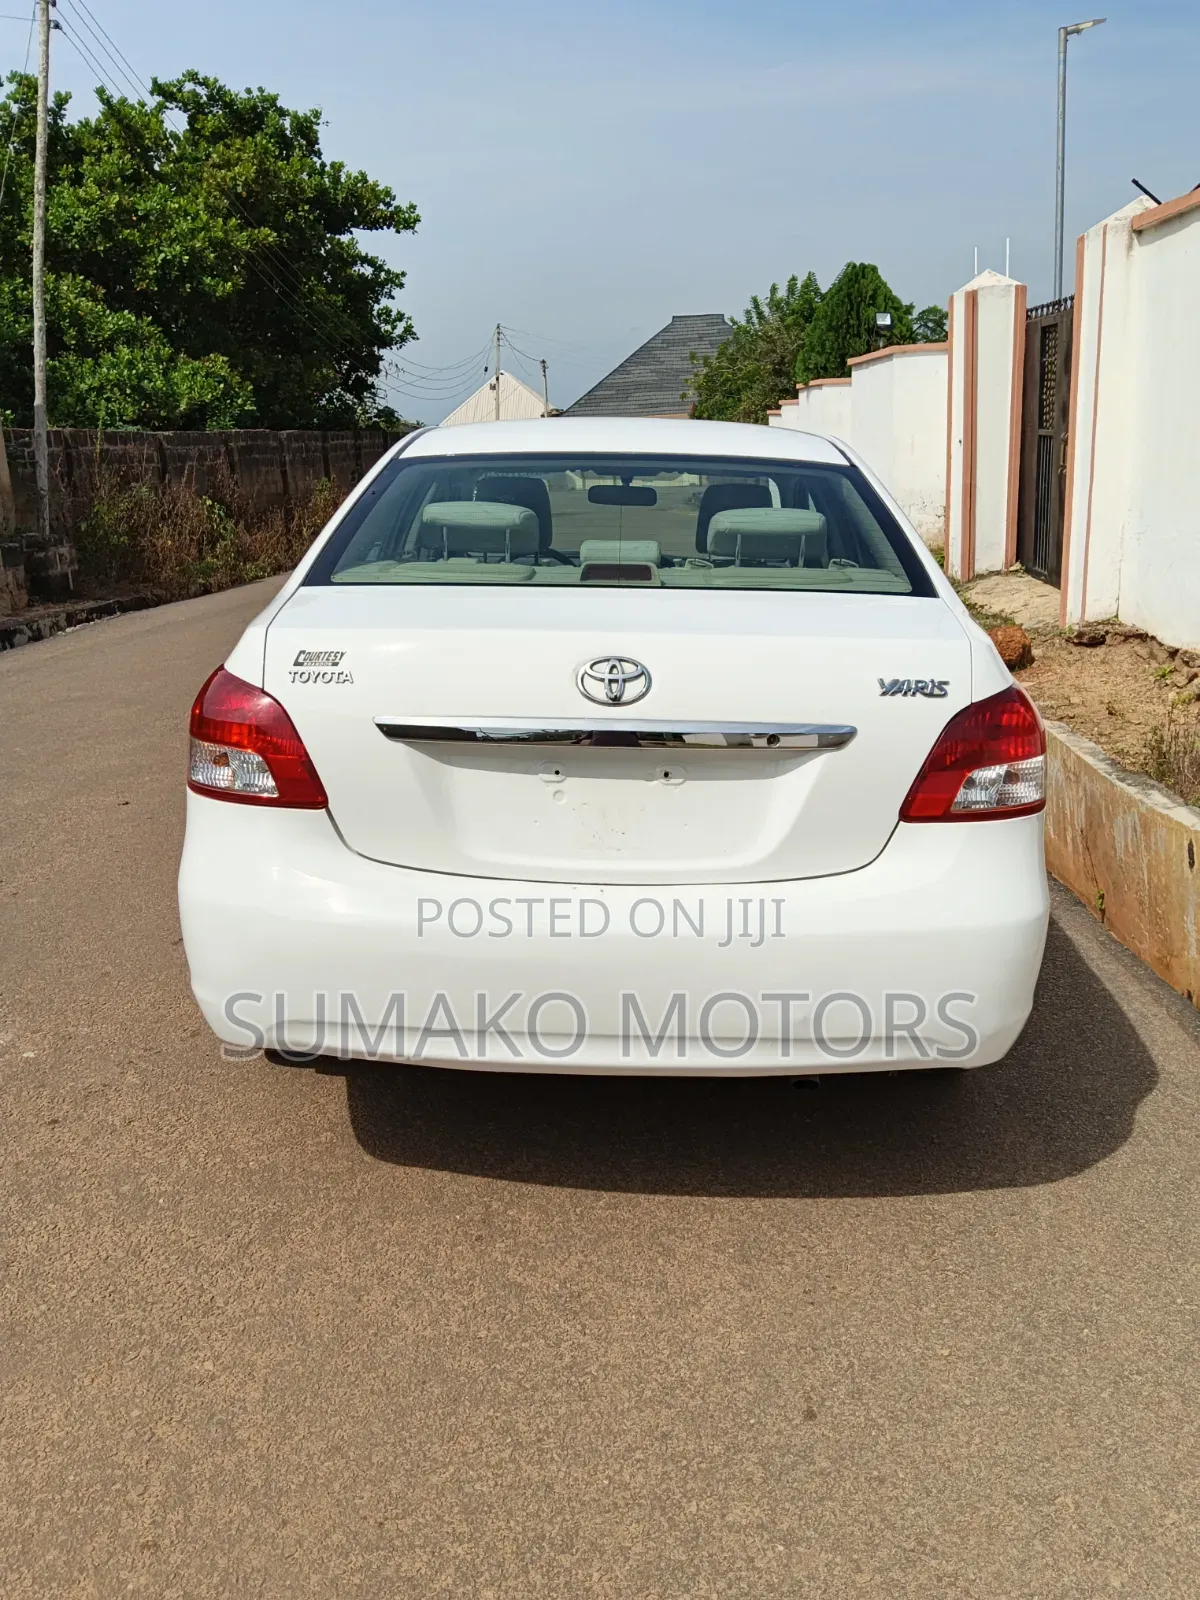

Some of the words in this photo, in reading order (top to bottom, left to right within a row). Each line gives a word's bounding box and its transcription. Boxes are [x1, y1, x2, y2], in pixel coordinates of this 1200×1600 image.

[293, 650, 347, 667] COURTESY
[288, 671, 354, 684] TOYOTA
[877, 677, 950, 698] YARIS
